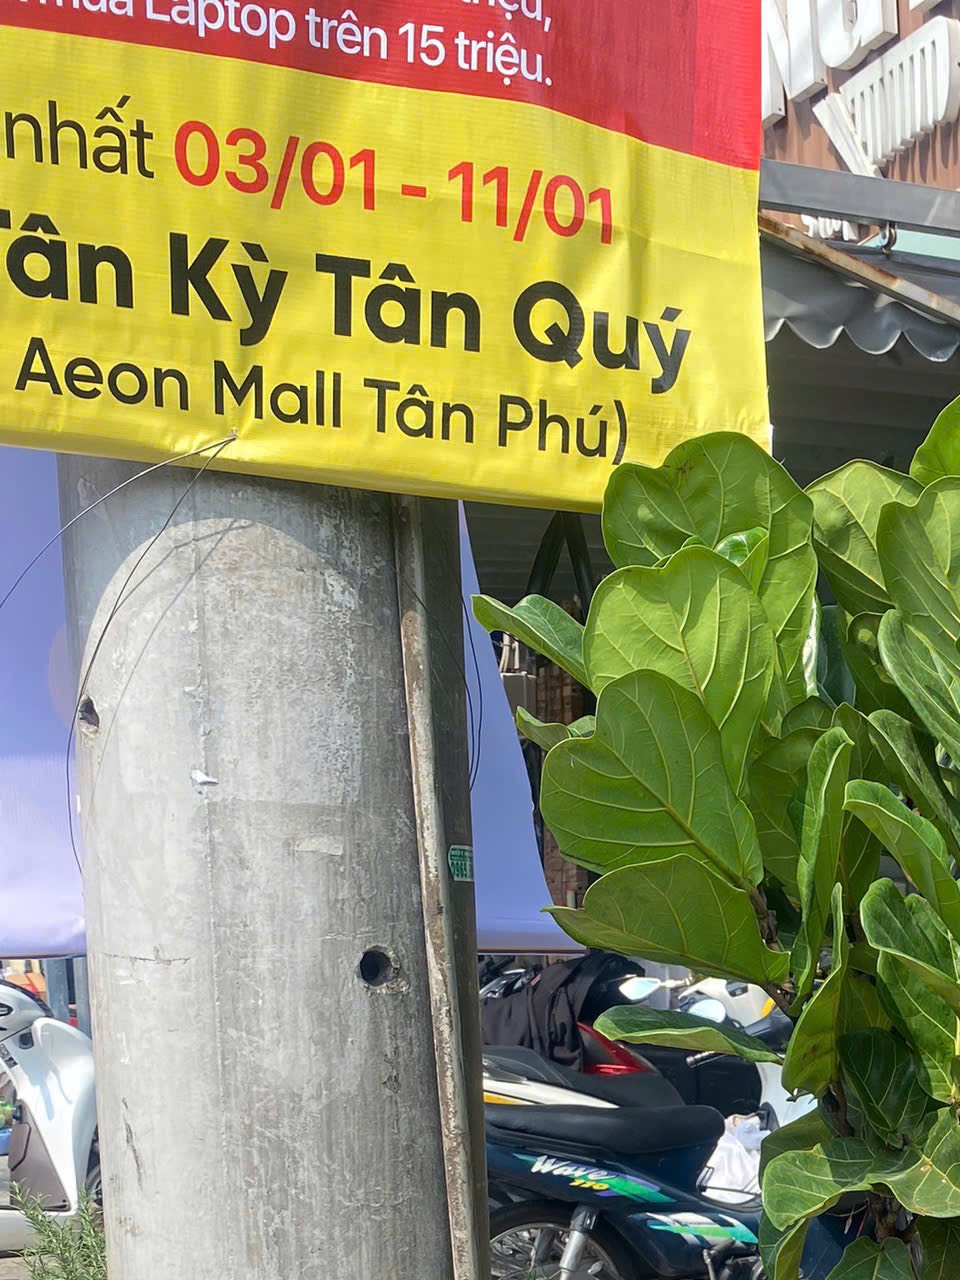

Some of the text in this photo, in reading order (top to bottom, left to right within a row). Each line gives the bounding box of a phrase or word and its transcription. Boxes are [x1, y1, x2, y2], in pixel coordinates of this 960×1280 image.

[146, 0, 296, 49] Laptop
[305, 8, 388, 60] trên
[398, 22, 446, 67] 15
[454, 30, 552, 87] triệu.
[5, 95, 613, 246] nhất 03/01 - 11/01
[0, 209, 692, 394] ân Kỳ Tân Quý
[15, 337, 628, 466] Aeon Mall Tân Phú)
[531, 1155, 619, 1181] Wave
